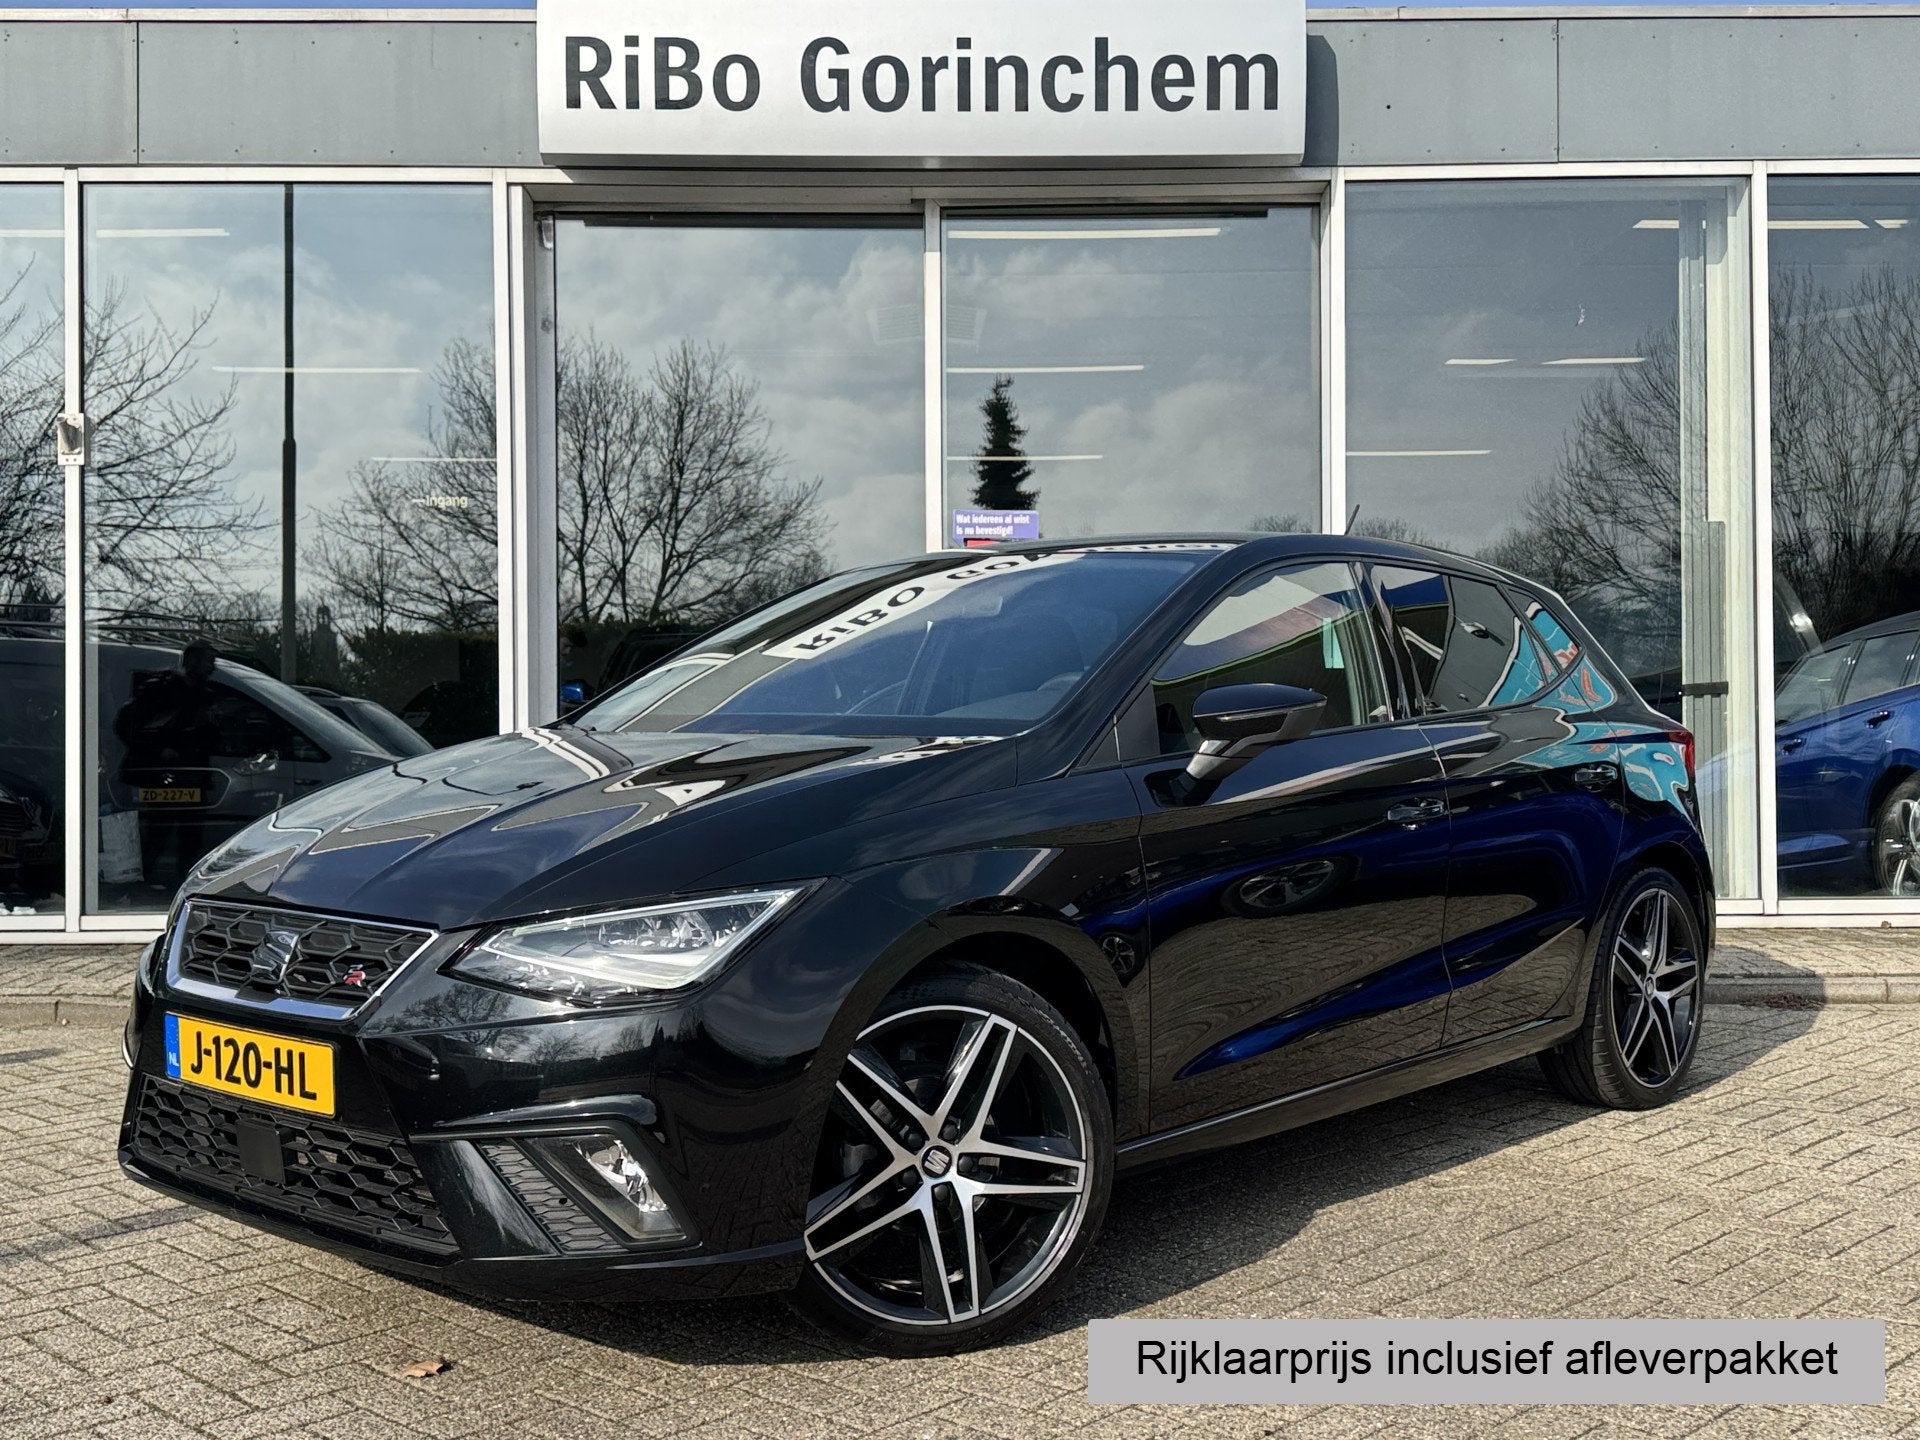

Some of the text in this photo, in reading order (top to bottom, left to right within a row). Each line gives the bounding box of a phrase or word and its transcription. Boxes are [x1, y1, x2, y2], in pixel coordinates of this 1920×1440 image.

[565, 36, 1279, 113] RiBo Gorinchem
[956, 514, 1030, 524] Wat iedereen al wist
[964, 527, 974, 535] nu
[975, 526, 1014, 537] bevestigd!
[143, 790, 195, 801] ZD-227-V
[168, 1031, 317, 1101] NL J-120-HL
